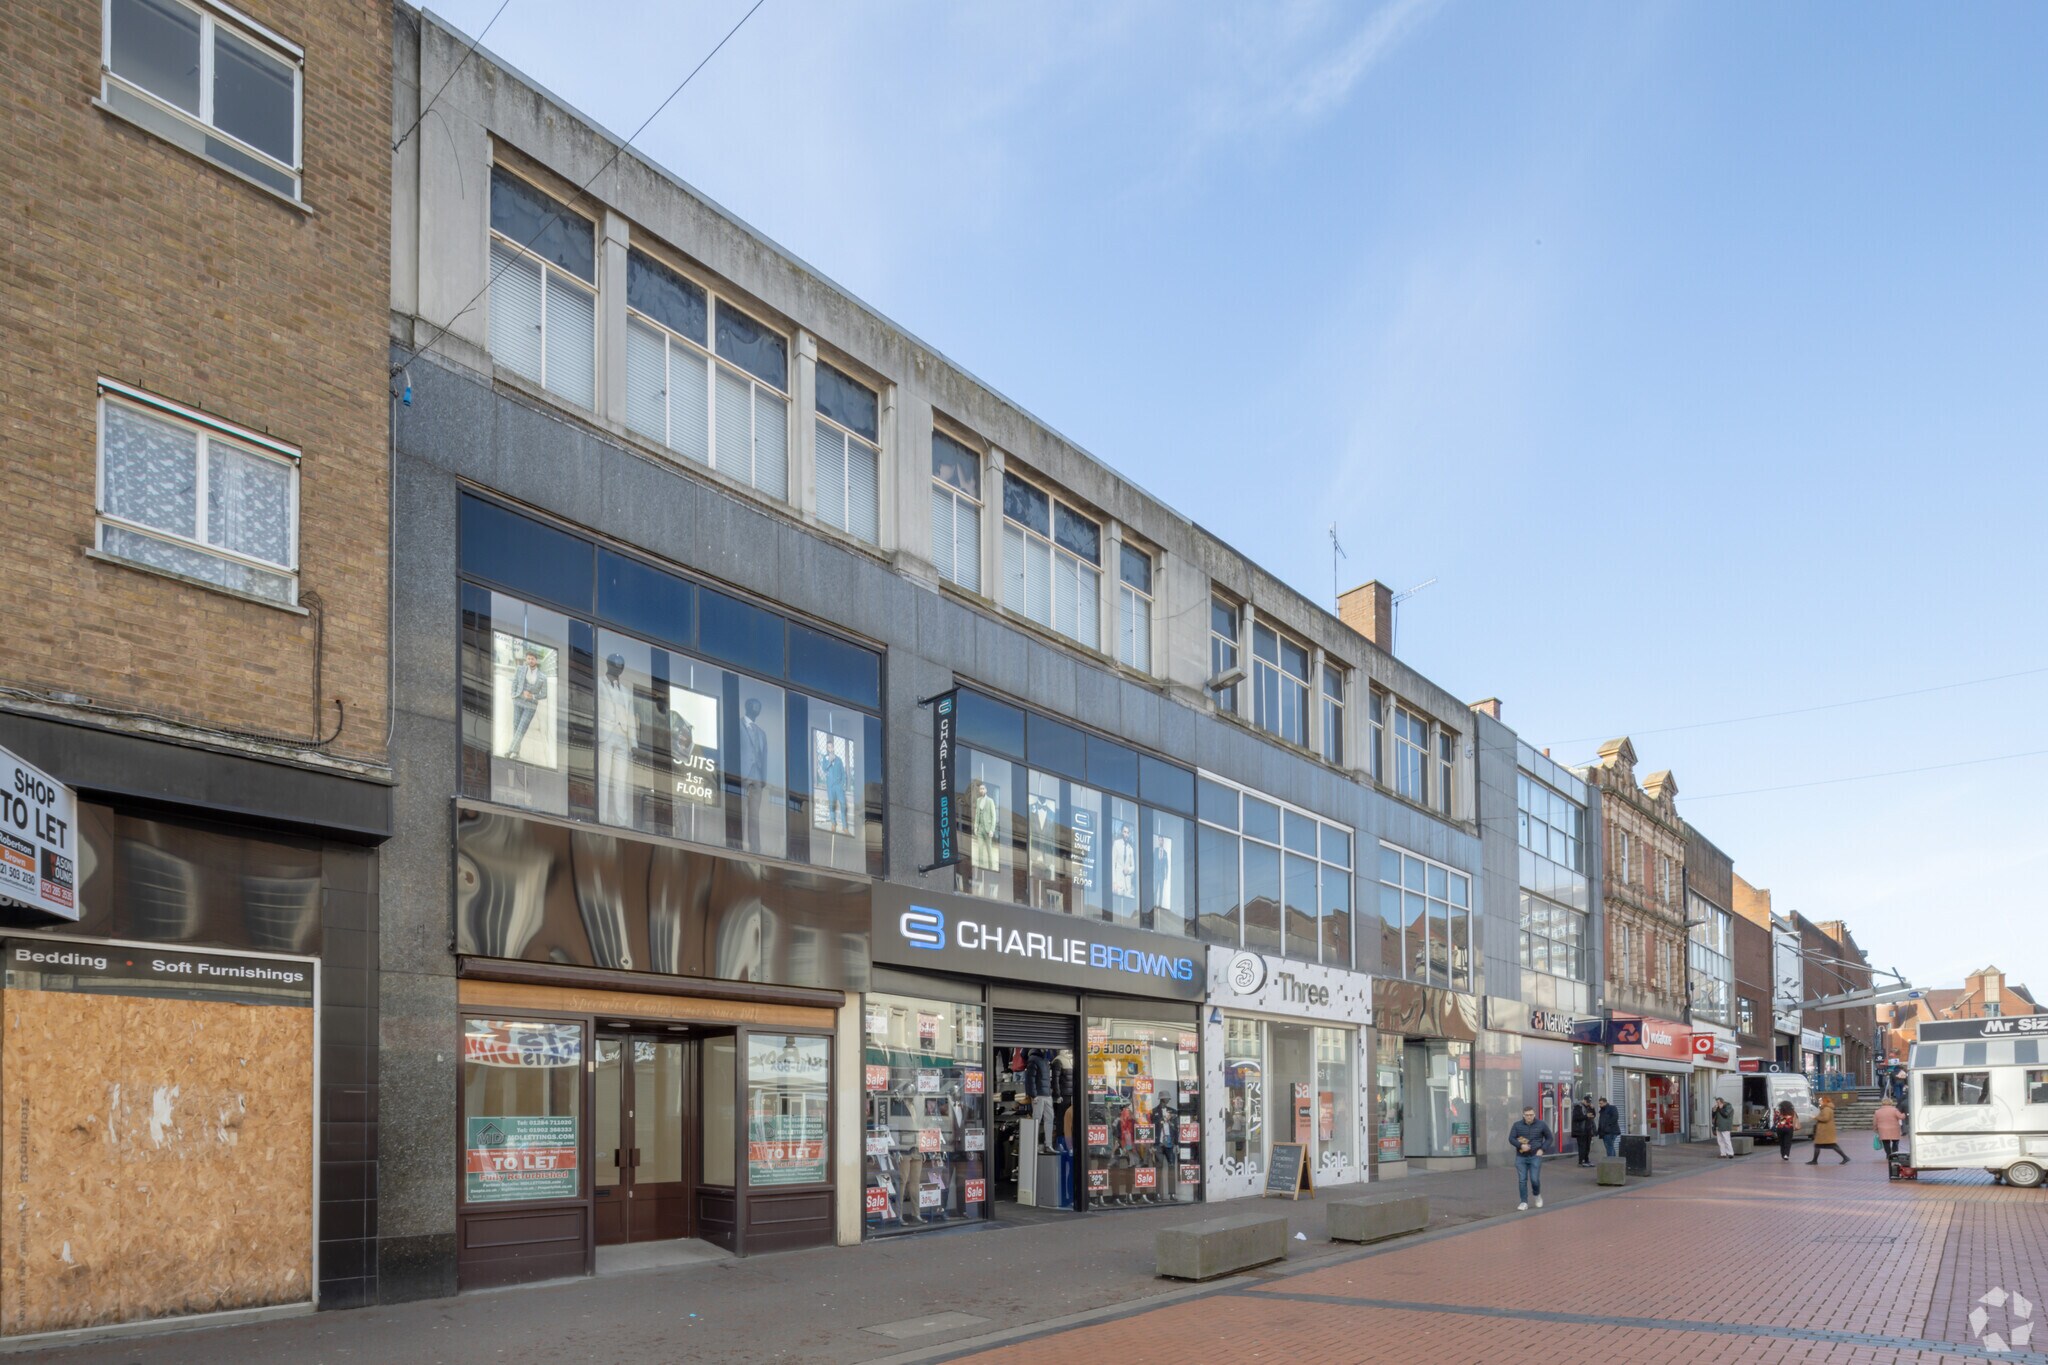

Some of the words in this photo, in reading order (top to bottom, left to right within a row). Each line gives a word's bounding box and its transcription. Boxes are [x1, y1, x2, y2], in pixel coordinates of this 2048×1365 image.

[939, 718, 949, 791] CHARLIE
[14, 768, 55, 808] SHOP
[676, 782, 713, 799] FLOOR
[0, 788, 28, 830] TO
[36, 808, 67, 849] LET
[940, 796, 951, 860] BROWNS
[1074, 833, 1091, 844] SUIT
[4, 849, 26, 867] Brown
[1073, 876, 1093, 888] FLOOR
[957, 920, 1086, 966] CHARLIE
[1089, 942, 1193, 981] BROWNS
[15, 948, 107, 970] Bedding
[152, 960, 191, 974] Soft
[198, 963, 303, 983] Furnishings
[1279, 972, 1329, 1007] Three
[1544, 1012, 1575, 1035] NatWest
[1985, 1020, 2013, 1032] Mr
[1181, 1040, 1196, 1048] Sale
[1651, 1032, 1672, 1046] vodafone
[866, 1074, 884, 1085] Sale
[966, 1079, 982, 1089] Sale
[1136, 1082, 1152, 1090] Sale
[1088, 1131, 1105, 1140] Sale
[1182, 1130, 1197, 1138] Sale
[921, 1136, 937, 1147] Sale
[768, 1149, 784, 1159] TO
[788, 1148, 811, 1159] LET
[1322, 1150, 1347, 1168] Sale
[493, 1157, 518, 1170] TO
[524, 1156, 556, 1169] LET
[1225, 1156, 1257, 1176] Sale
[479, 1172, 504, 1182] Fully
[507, 1170, 568, 1180] Refurbished
[1137, 1174, 1153, 1183] Sale
[967, 1187, 982, 1197] Sale
[866, 1195, 884, 1207] Sale
